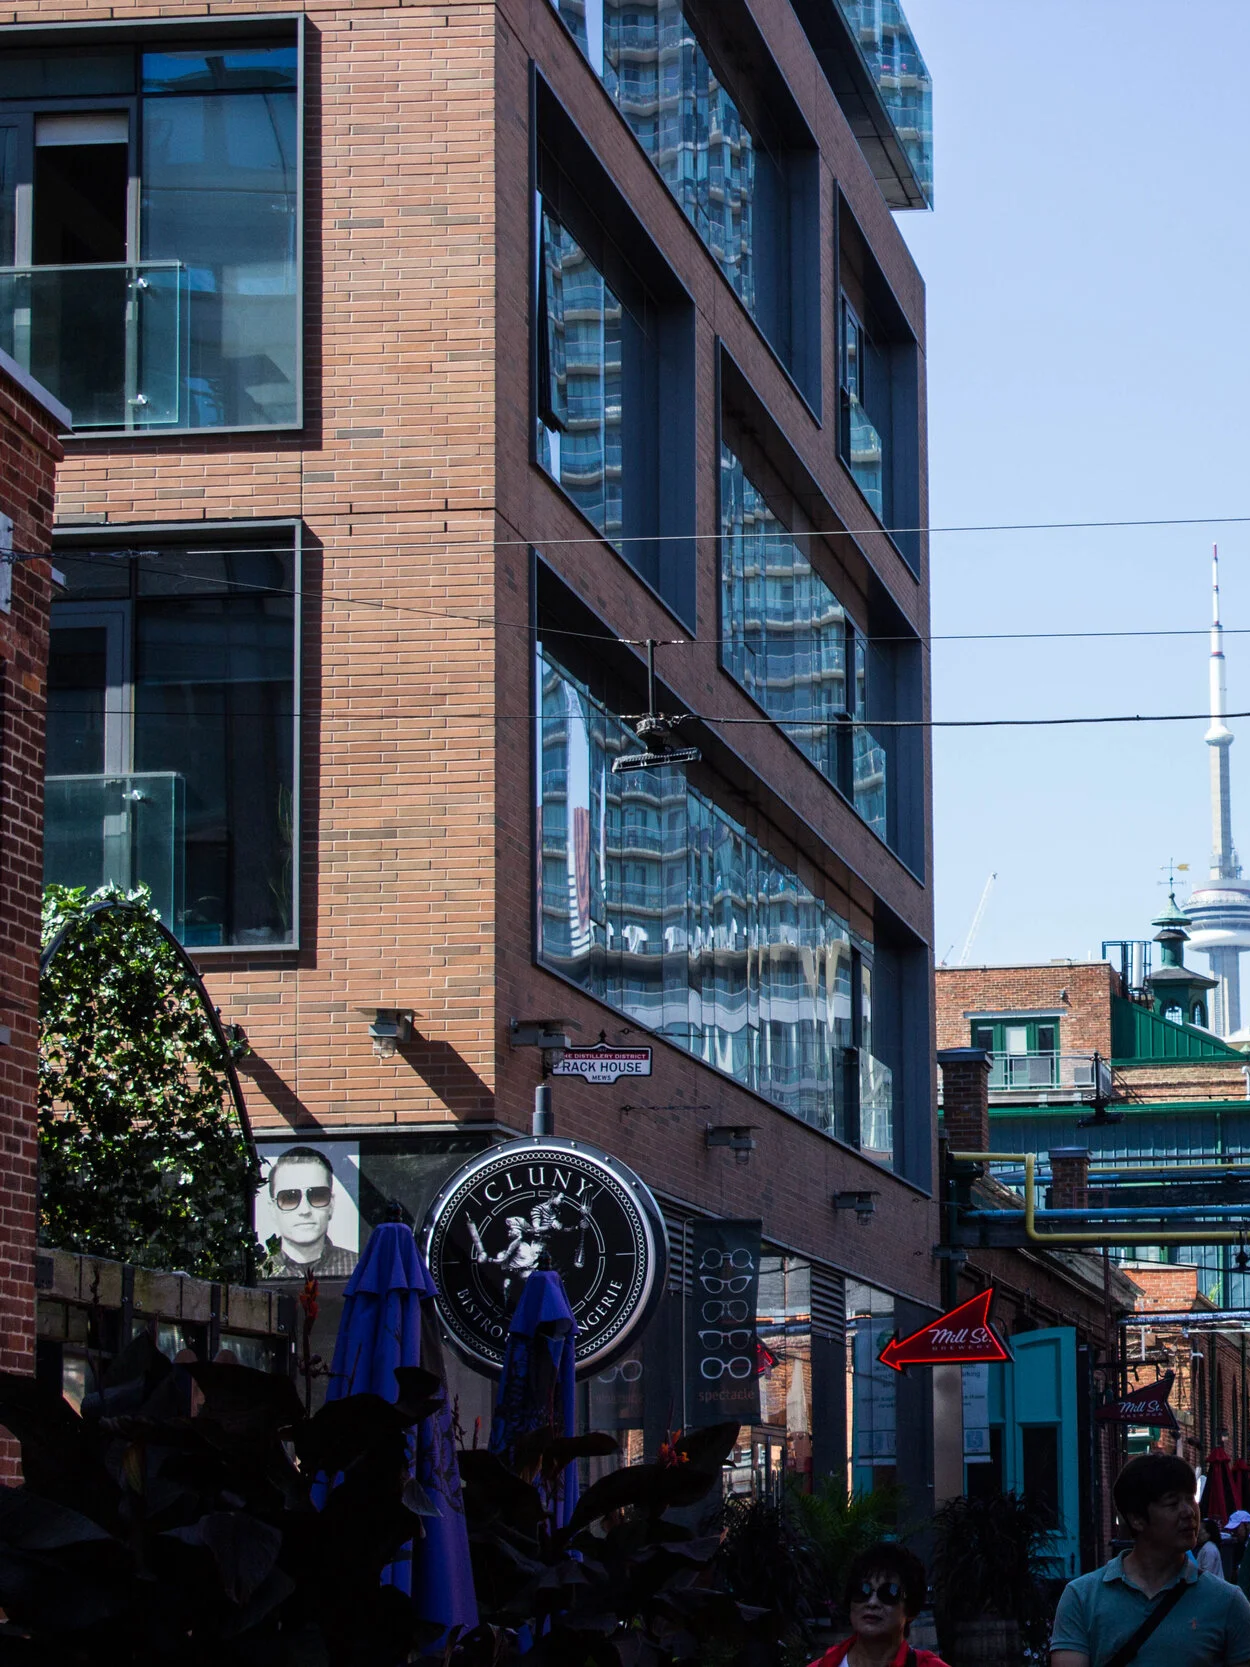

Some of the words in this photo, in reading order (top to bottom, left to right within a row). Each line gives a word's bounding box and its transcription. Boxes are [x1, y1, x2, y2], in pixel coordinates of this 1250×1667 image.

[562, 1062, 597, 1073] RACK
[600, 1061, 642, 1073] HOUSE
[484, 1166, 594, 1202] CLUNY
[457, 1288, 504, 1339] BISTRO
[575, 1279, 624, 1338] NGERIE
[928, 1328, 969, 1345] Mill
[969, 1327, 993, 1344] St.
[698, 1387, 755, 1403] spectacle
[1117, 1401, 1147, 1413] Mill
[1147, 1400, 1164, 1413] St.
